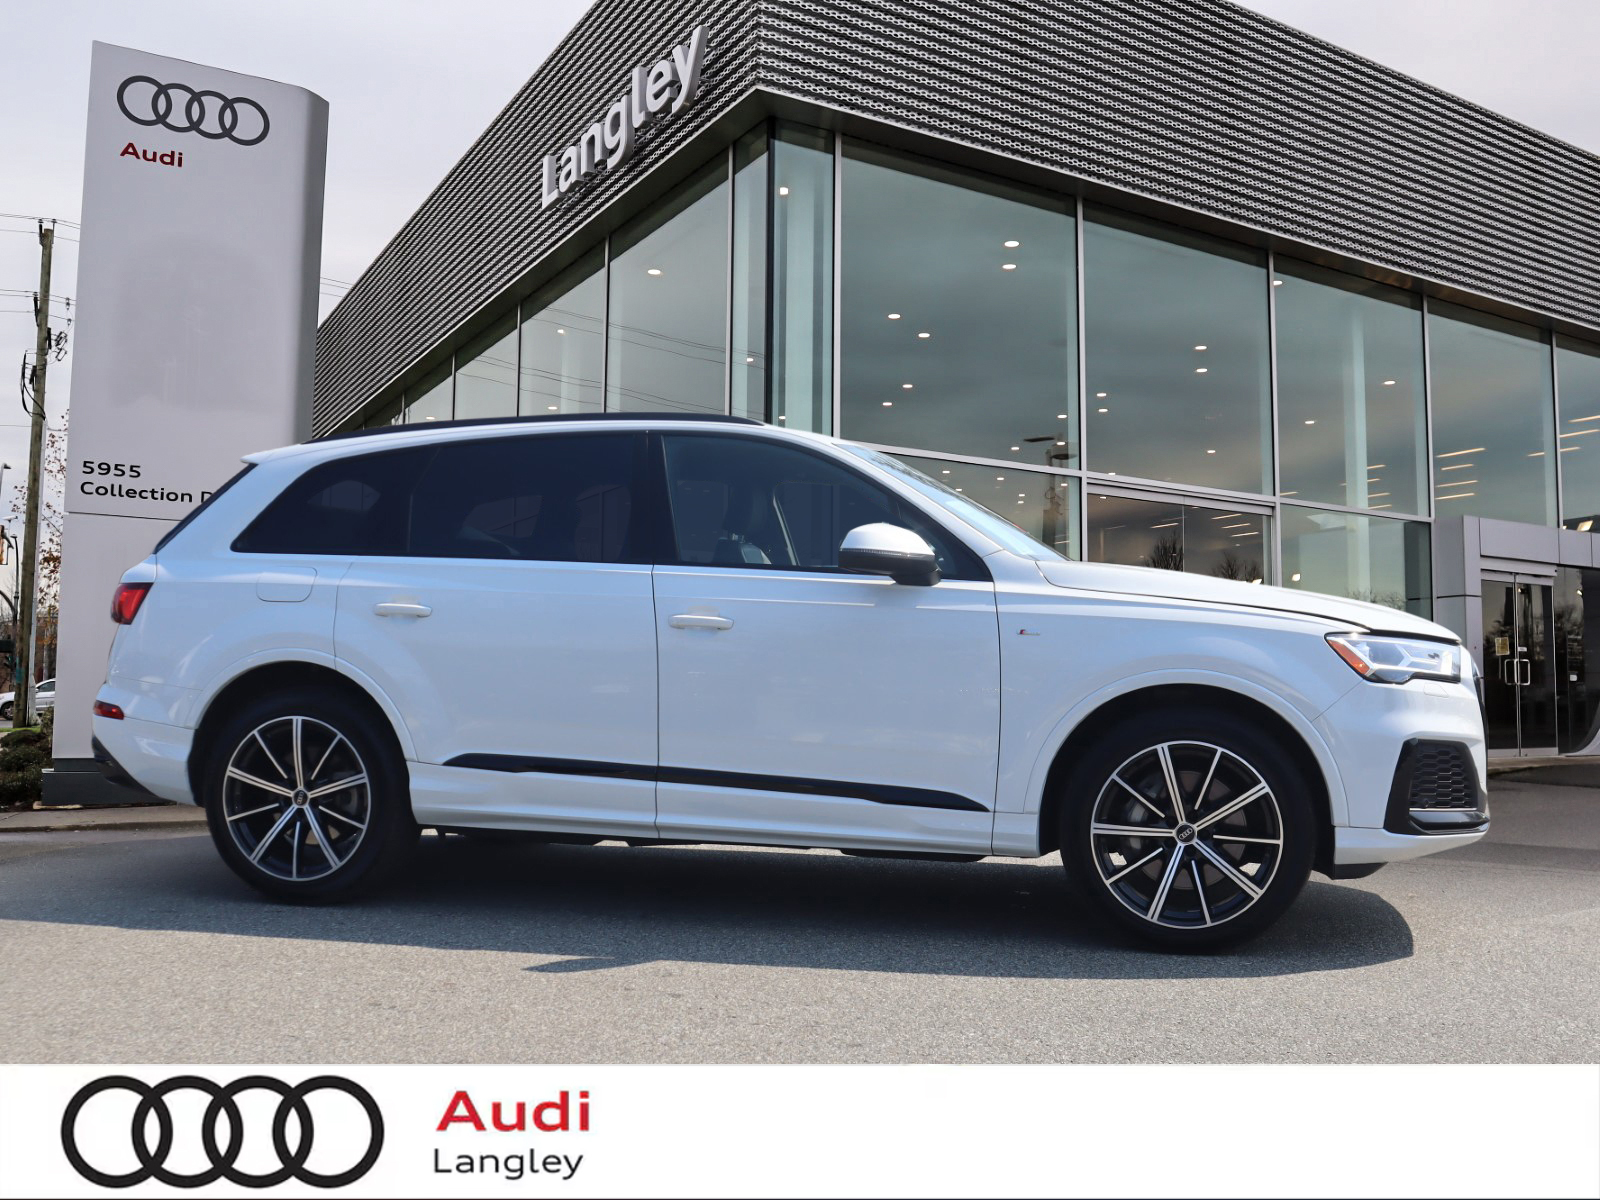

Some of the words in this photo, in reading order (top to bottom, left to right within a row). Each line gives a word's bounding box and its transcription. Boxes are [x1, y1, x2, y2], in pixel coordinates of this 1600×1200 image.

[541, 25, 710, 209] Langley
[119, 142, 184, 168] Audi
[82, 460, 142, 478] 5955
[80, 481, 193, 503] Collection
